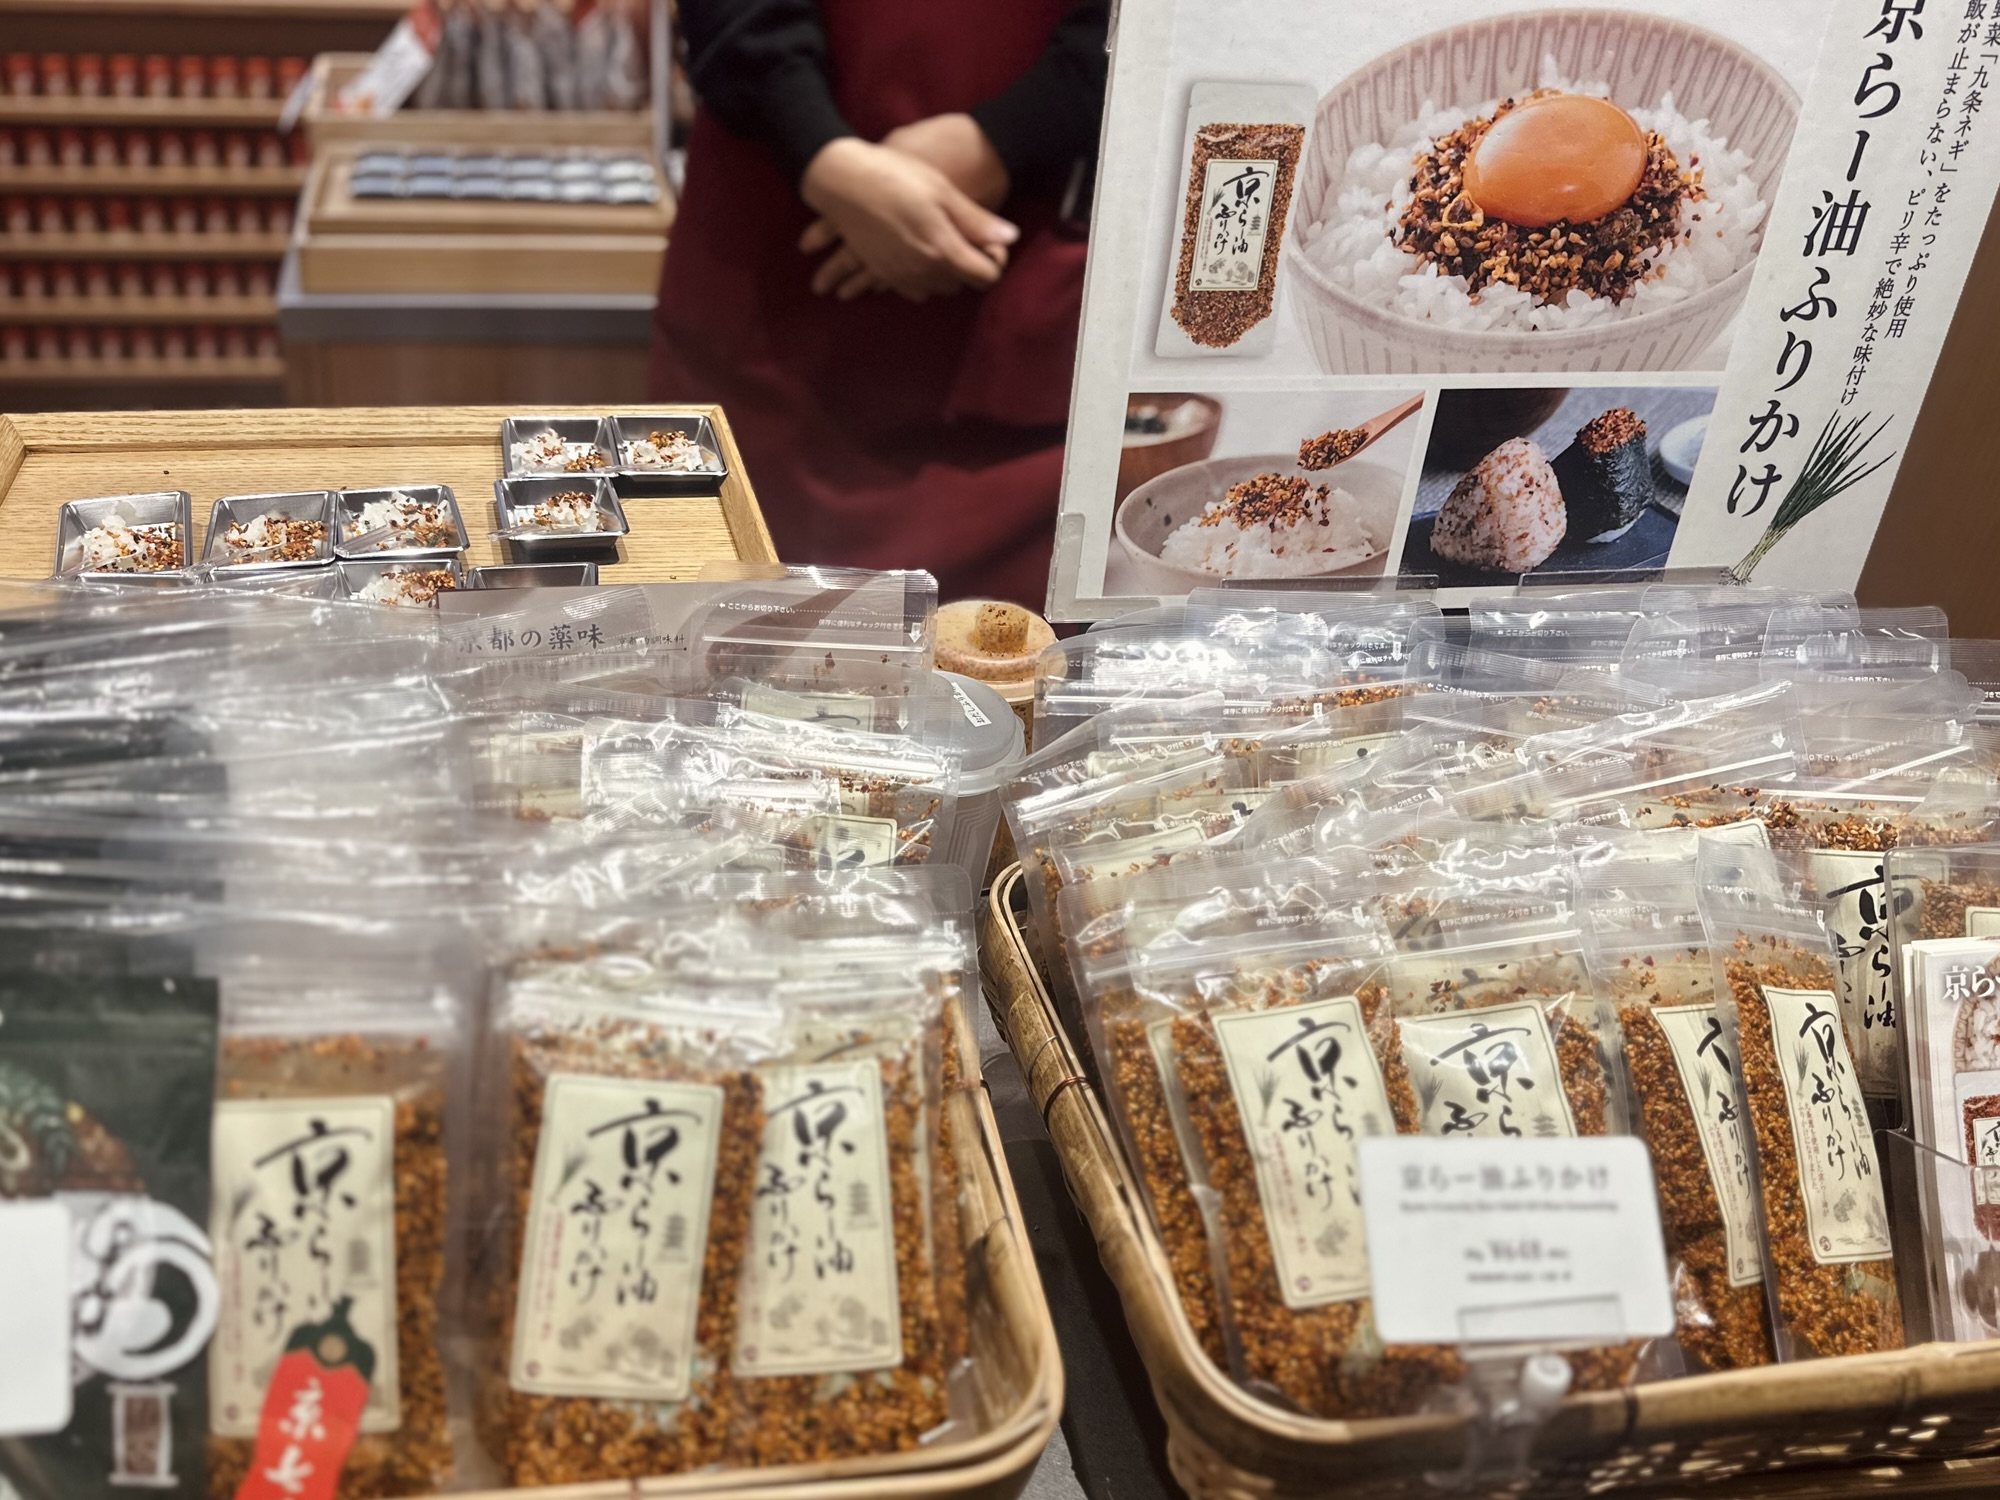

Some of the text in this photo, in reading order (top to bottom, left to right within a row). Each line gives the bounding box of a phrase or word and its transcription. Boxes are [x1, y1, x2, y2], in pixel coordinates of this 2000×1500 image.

[1725, 0, 1926, 517] 京らー油ふりかけ
[728, 602, 796, 614] ここからお切り下さい。
[1439, 905, 1549, 927] 保存に便利なチャック付きです。
[1942, 965, 2000, 1002] 京ら
[765, 1080, 865, 1281] 京らー油
[1281, 1097, 1334, 1213] ふりかけ
[1811, 1072, 1846, 1181] ふりかけ
[253, 1118, 374, 1308] 京らー
[570, 1178, 624, 1305] ふりかけ
[586, 1097, 703, 1306] 京らー油
[756, 1162, 806, 1285] ふりかけ
[263, 1375, 328, 1500] 京七
